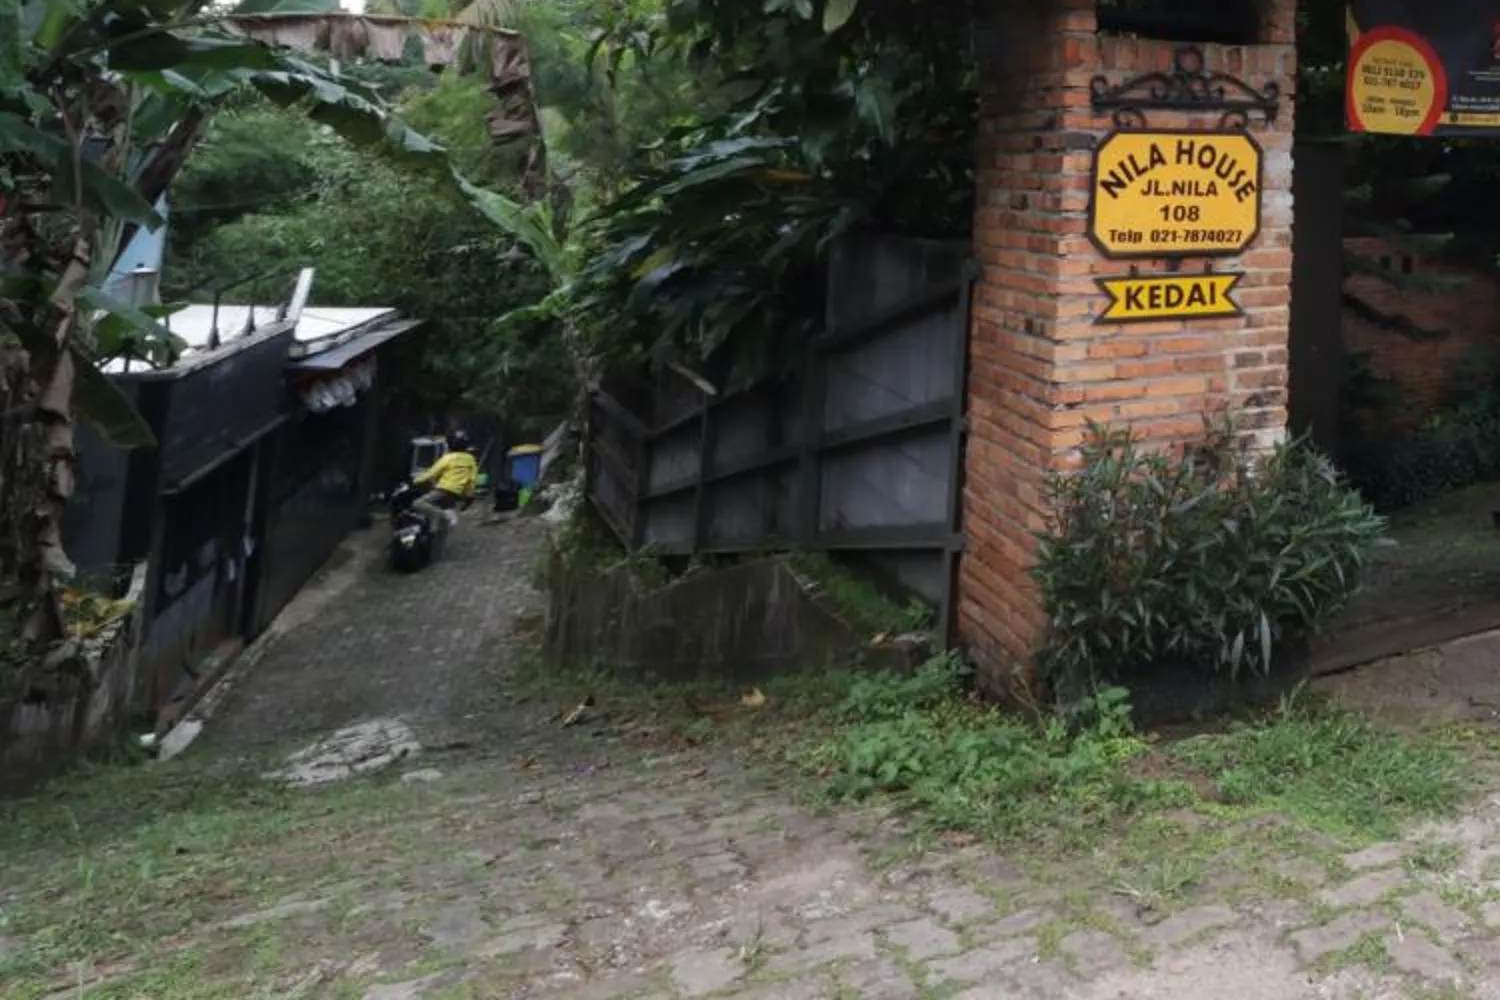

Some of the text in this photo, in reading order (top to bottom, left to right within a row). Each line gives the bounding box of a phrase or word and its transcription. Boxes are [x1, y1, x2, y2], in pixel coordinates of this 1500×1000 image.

[1100, 139, 1256, 203] NILA HOUSE
[1160, 205, 1200, 222] 108
[1109, 229, 1242, 243] Telp 021-7874027
[1125, 282, 1217, 311] KEDAI
